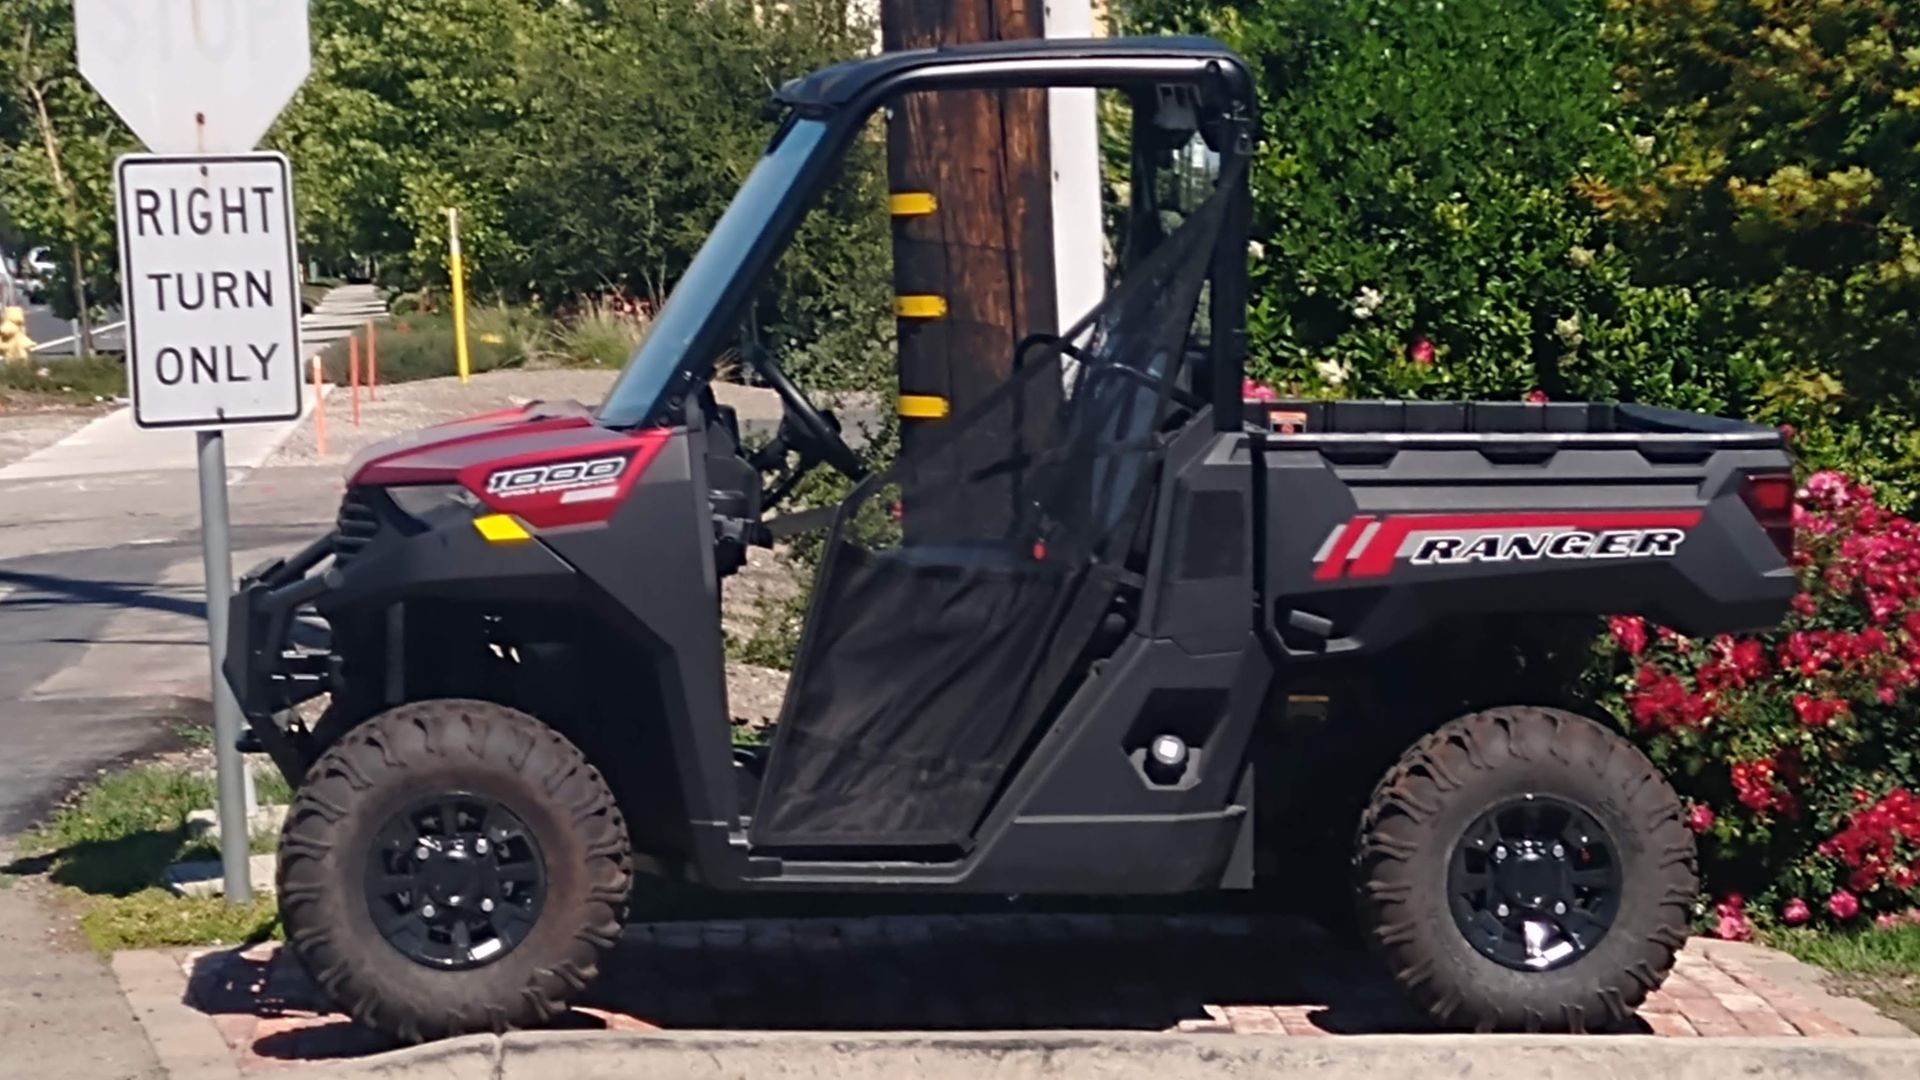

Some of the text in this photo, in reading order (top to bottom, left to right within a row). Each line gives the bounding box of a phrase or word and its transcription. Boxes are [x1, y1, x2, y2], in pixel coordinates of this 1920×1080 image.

[135, 187, 274, 236] RIGHT
[147, 270, 273, 312] TURN
[155, 343, 279, 386] ONLY
[488, 457, 626, 493] 1000
[1409, 529, 1685, 564] RANGER
